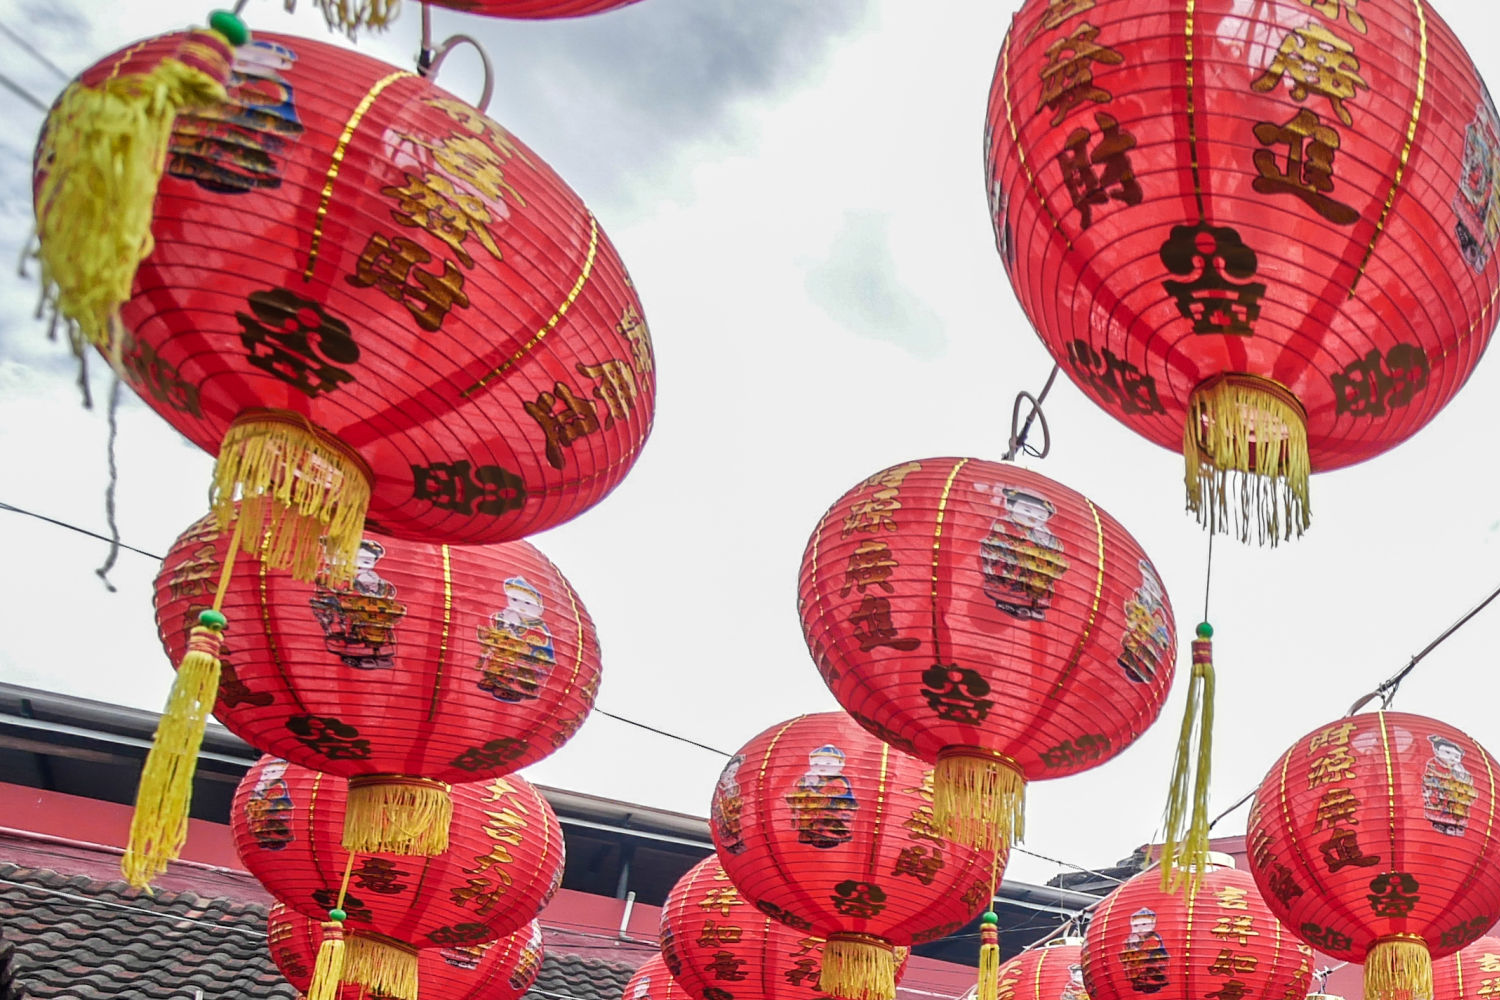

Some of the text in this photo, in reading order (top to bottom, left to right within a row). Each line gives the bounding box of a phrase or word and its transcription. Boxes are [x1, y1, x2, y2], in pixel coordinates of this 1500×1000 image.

[450, 778, 529, 915] 大吉大利
[1308, 722, 1381, 872] 財源廣進
